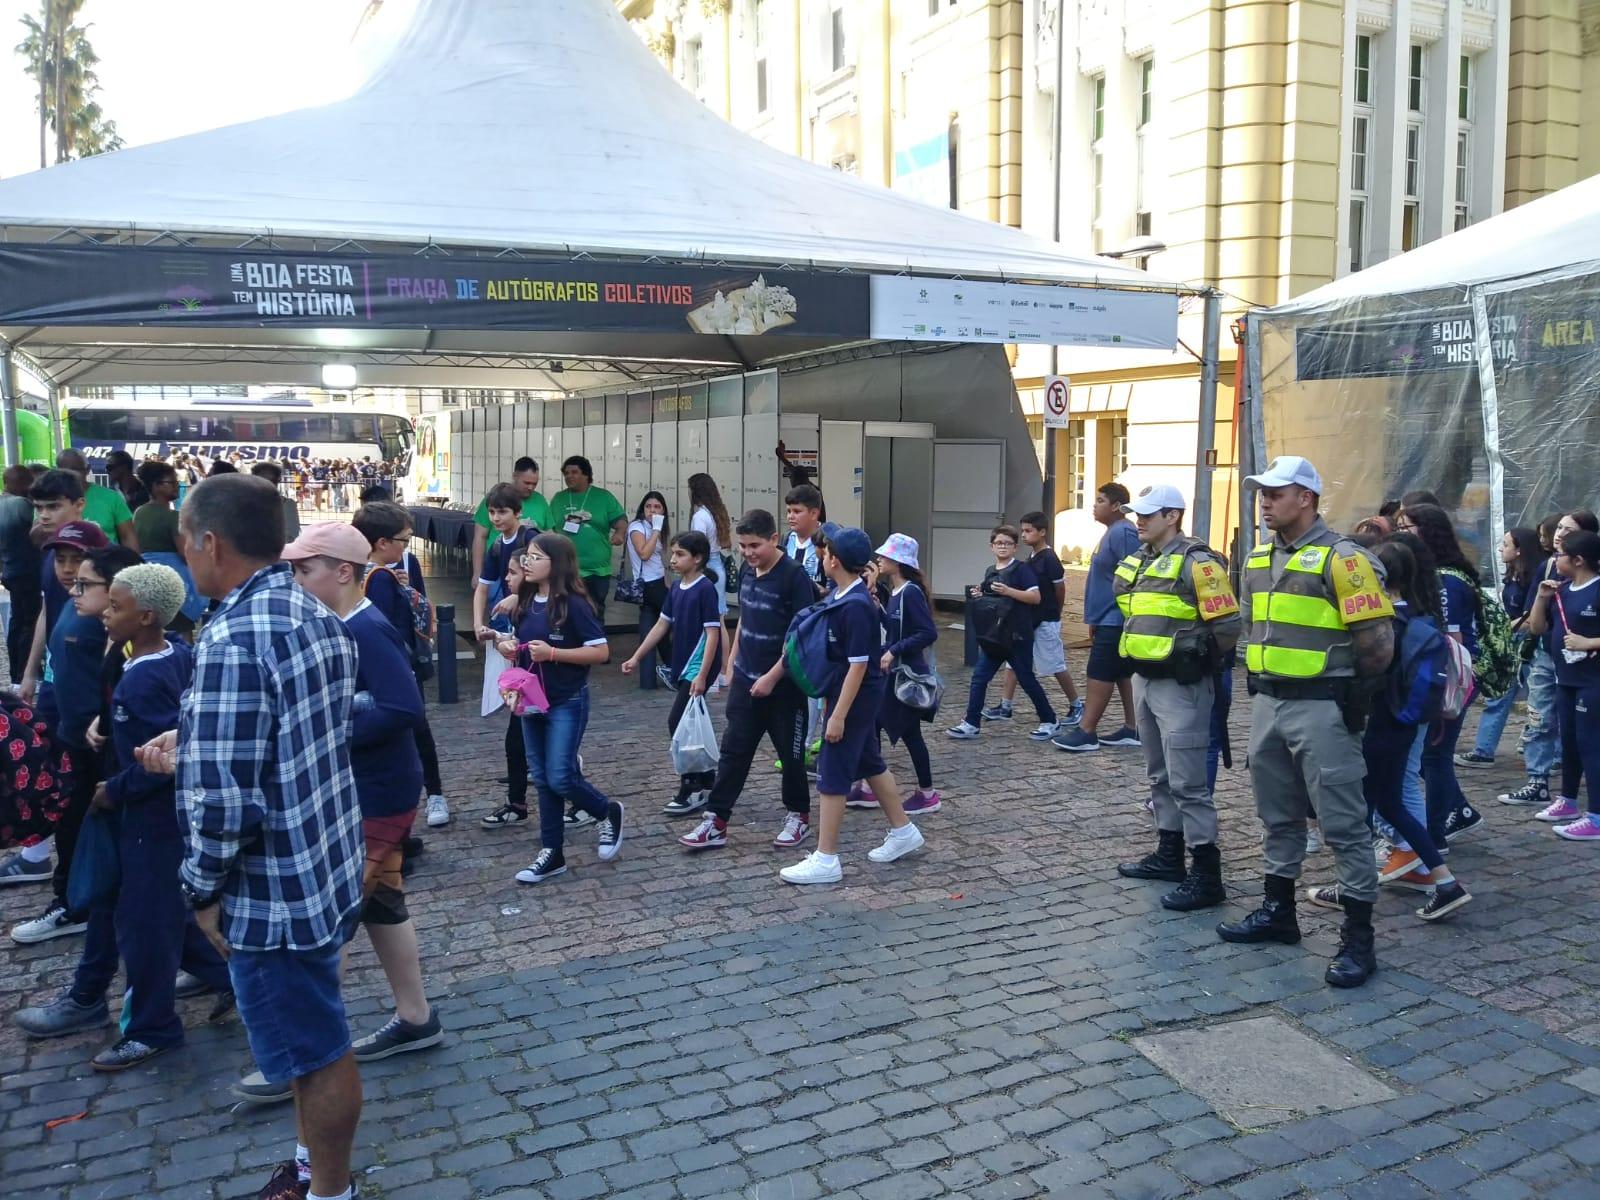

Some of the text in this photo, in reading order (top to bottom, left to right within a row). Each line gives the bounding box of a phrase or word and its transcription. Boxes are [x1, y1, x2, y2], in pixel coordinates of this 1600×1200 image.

[230, 263, 244, 282] UMA
[246, 262, 293, 288] BOA
[296, 264, 354, 286] FESTA
[232, 288, 356, 316] TEM HISTÓRIA
[386, 277, 693, 305] PRAÇA DE AUTÓGRAFOS COLETIVOS
[1442, 319, 1473, 342] BOA
[1205, 594, 1235, 613] BPM
[1344, 592, 1383, 614] BPM
